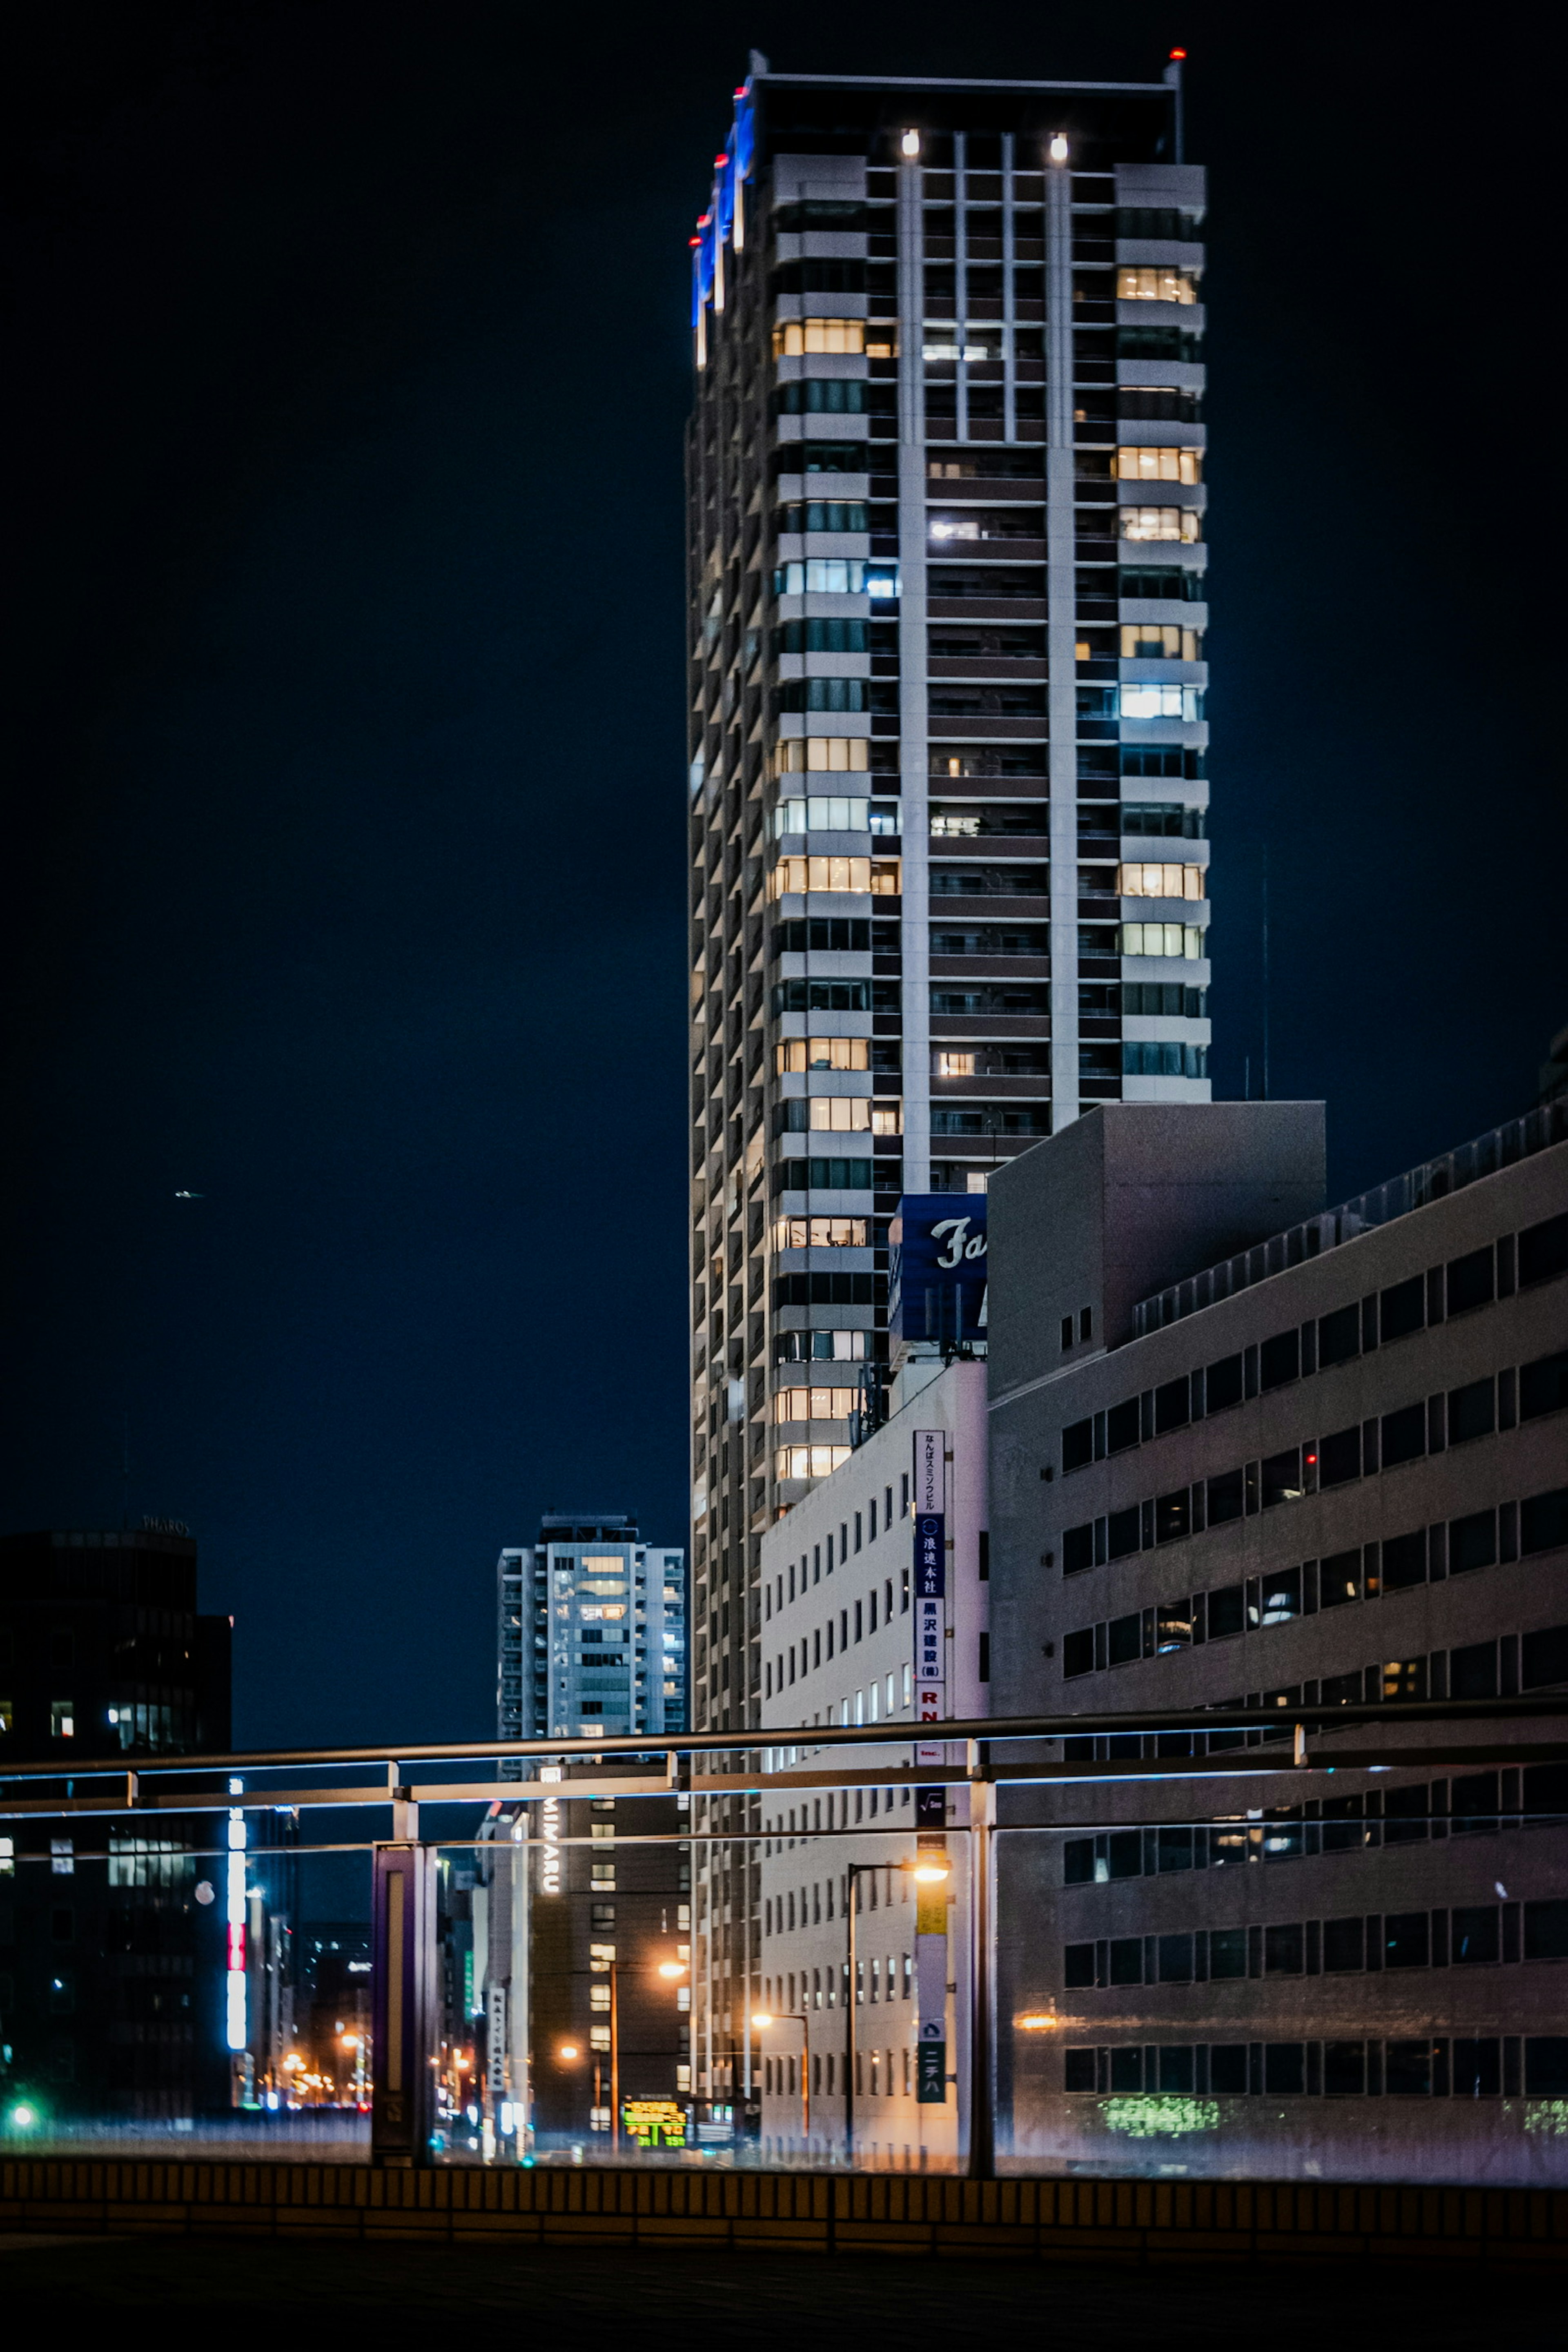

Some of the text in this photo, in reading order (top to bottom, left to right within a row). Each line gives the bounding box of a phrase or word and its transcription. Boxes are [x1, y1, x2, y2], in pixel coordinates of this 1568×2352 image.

[925, 1435, 934, 1510] なんばスミソウビル
[924, 2051, 939, 2092] ニチハ
